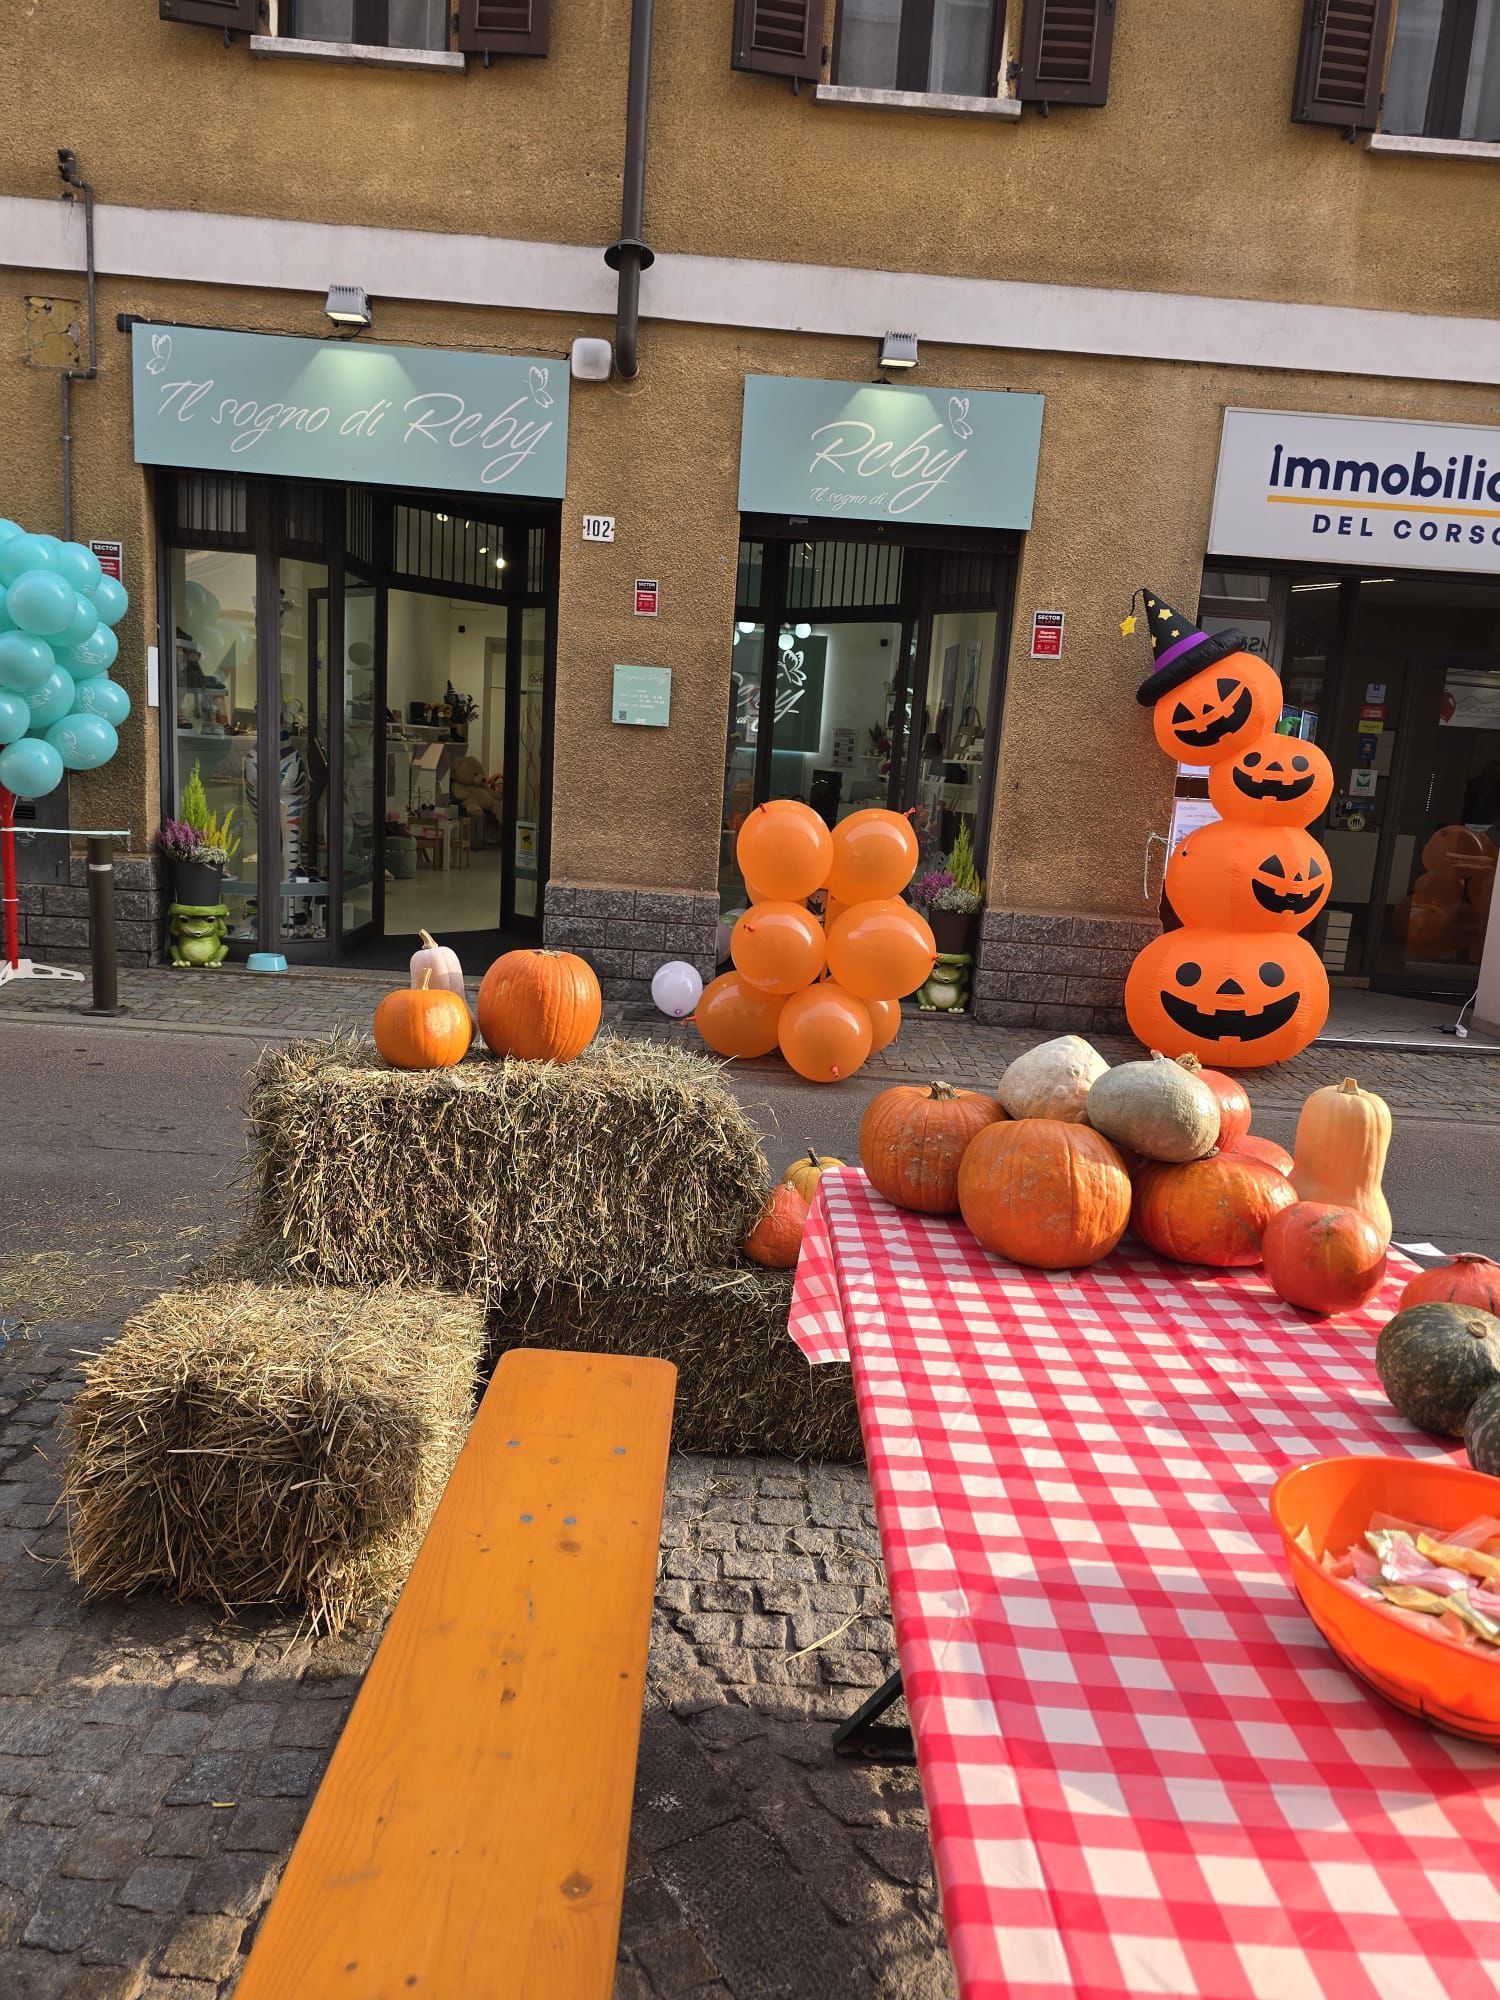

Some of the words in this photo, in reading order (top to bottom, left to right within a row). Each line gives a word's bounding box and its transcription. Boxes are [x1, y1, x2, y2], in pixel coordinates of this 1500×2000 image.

[211, 399, 331, 453] sogno
[339, 399, 393, 437] di
[403, 392, 553, 484] Reby
[810, 420, 968, 514] Reby
[827, 492, 867, 512] sogno
[869, 492, 889, 505] di
[586, 519, 611, 538] 102
[1312, 514, 1373, 537] DEL
